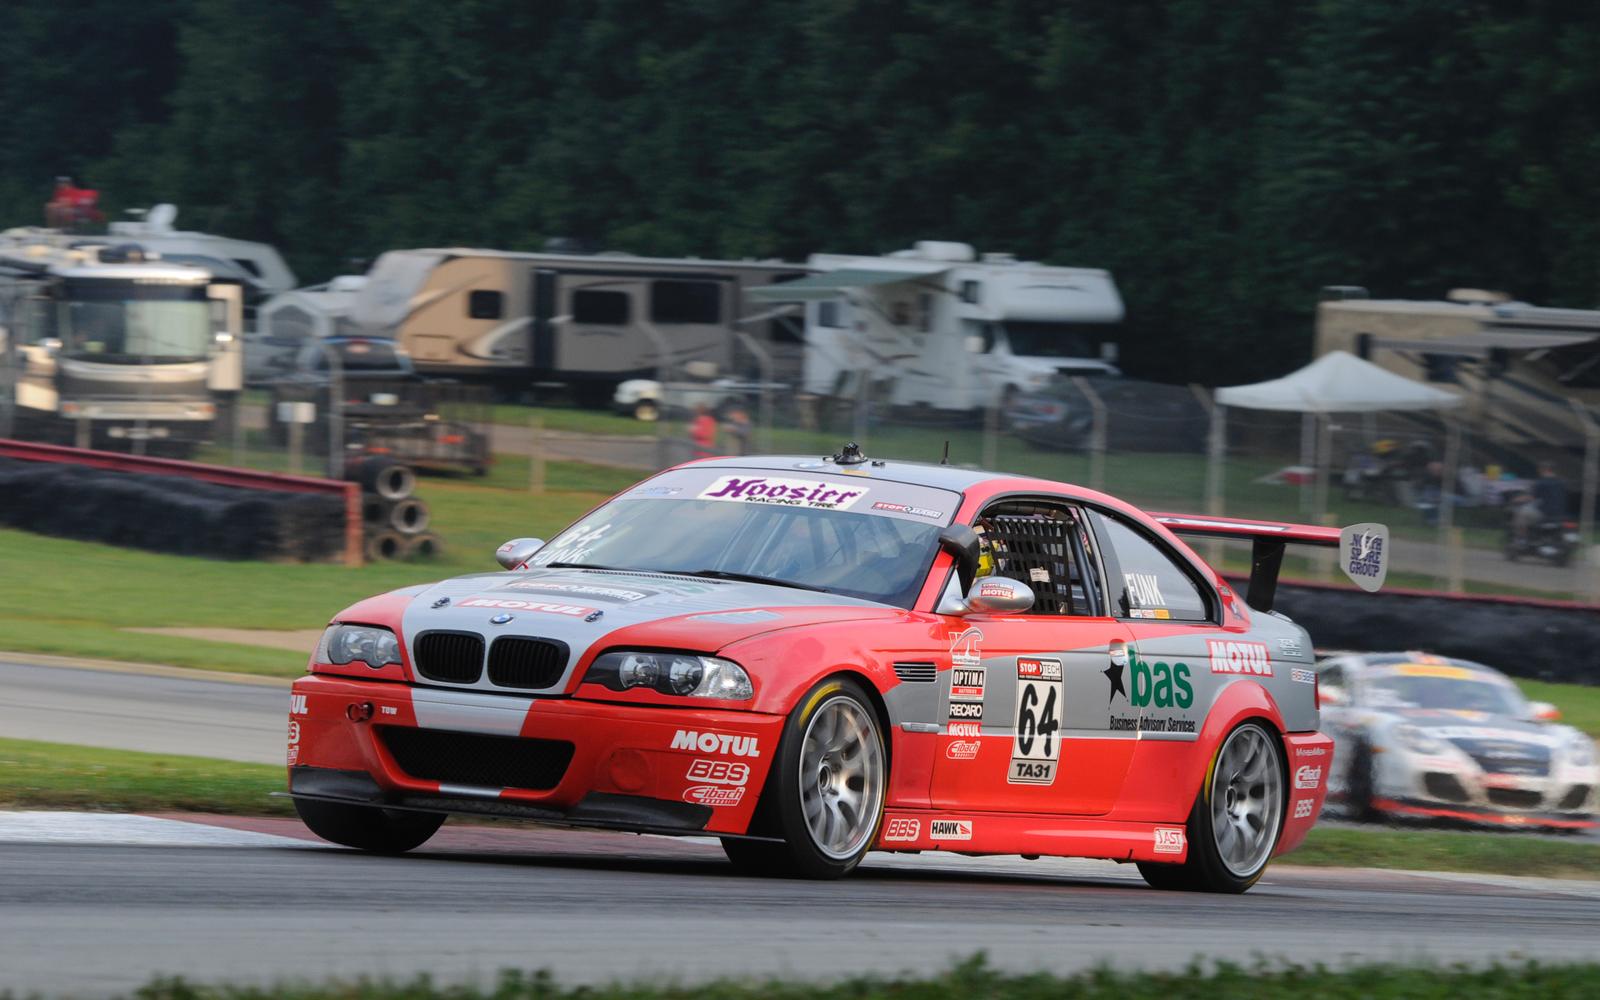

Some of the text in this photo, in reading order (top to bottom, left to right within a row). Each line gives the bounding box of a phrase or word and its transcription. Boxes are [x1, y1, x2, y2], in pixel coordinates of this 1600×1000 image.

[705, 478, 859, 504] Hoosier
[744, 496, 837, 508] RACING TIRE
[1349, 561, 1380, 577] GROUP
[982, 589, 1012, 598] MOTUL
[1124, 573, 1166, 605] FUNK
[461, 599, 586, 614] MOTUL
[1209, 641, 1273, 675] MOTUL
[1019, 663, 1060, 674] STOP TECH
[953, 671, 983, 686] OPTIMA
[1128, 648, 1194, 709] bas
[381, 706, 397, 715] TOW
[950, 704, 982, 717] RECARO
[1018, 683, 1058, 757] 64
[1109, 713, 1195, 732] Business Advisory Services
[949, 723, 981, 737] MOTUL
[670, 730, 760, 757] MOTUL
[687, 760, 749, 783] BBS
[1016, 763, 1051, 778] TA31
[683, 786, 745, 805] Eibach
[886, 819, 920, 840] BBS
[931, 822, 959, 834] HAWK
